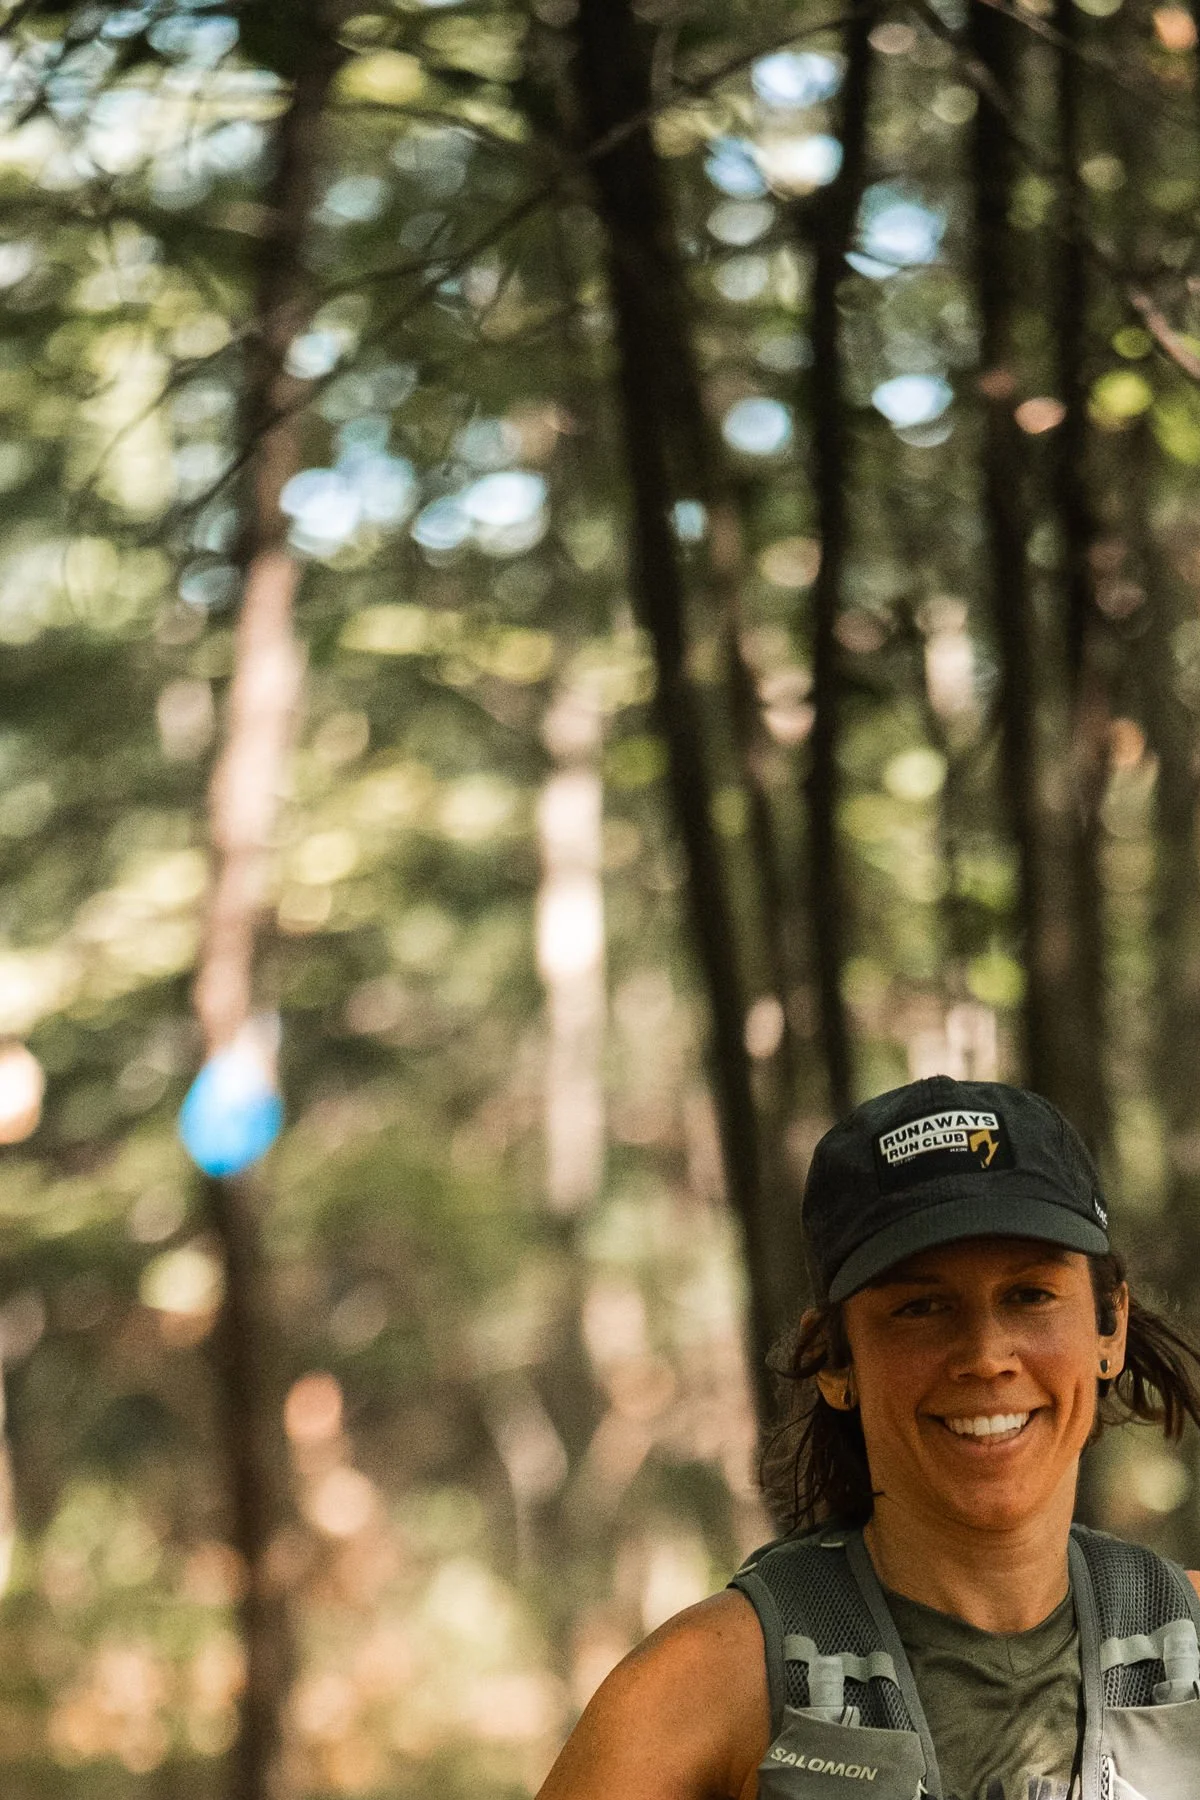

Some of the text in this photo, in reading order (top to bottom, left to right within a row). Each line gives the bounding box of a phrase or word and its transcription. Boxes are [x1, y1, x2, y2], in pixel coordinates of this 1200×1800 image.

[882, 1114, 995, 1150] RUNAWAYS
[889, 1132, 965, 1160] RUN CLUB
[770, 1747, 878, 1781] SALOMON
